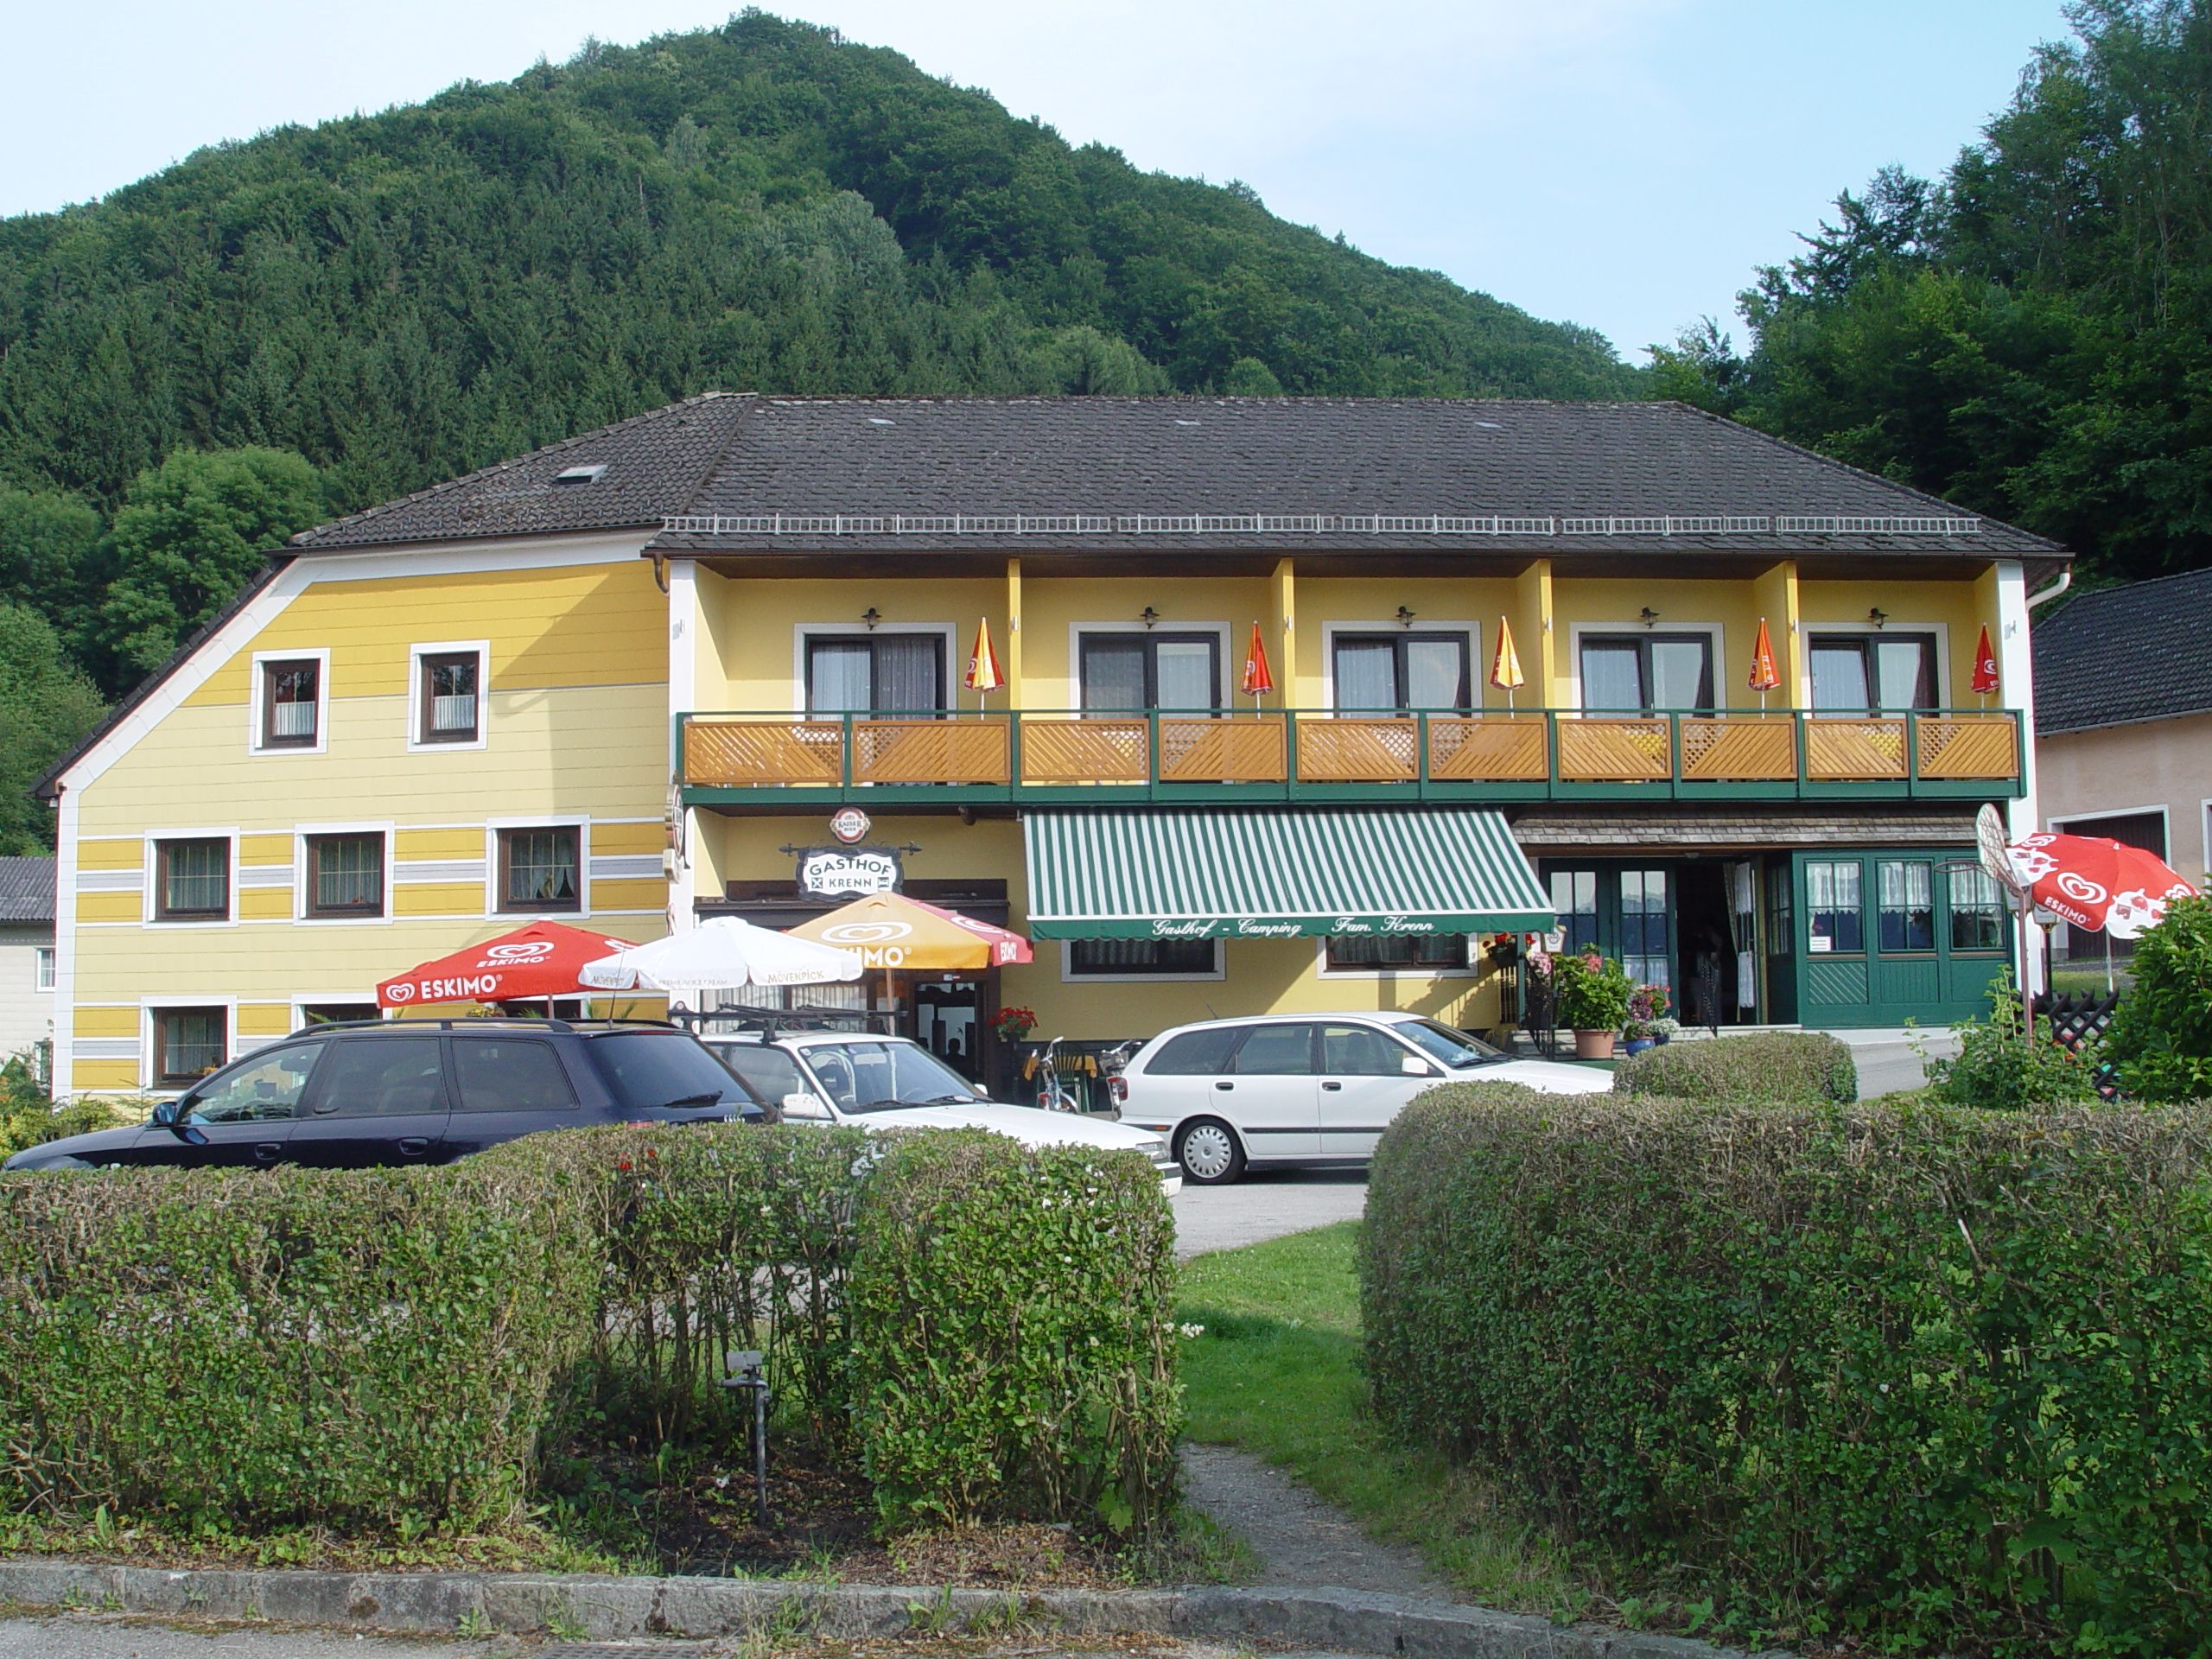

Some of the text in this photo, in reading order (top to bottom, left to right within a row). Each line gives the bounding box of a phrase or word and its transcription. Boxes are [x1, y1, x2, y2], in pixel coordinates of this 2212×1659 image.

[837, 820, 862, 829] KAISER
[810, 858, 892, 876] GASTHOF
[829, 877, 872, 888] KRENN
[2044, 895, 2087, 925] ESKIMO
[1152, 918, 1218, 938] Gasthof
[1237, 918, 1303, 938] Camping
[476, 956, 545, 969] ESKIMO
[421, 974, 497, 1000] ESKIMO
